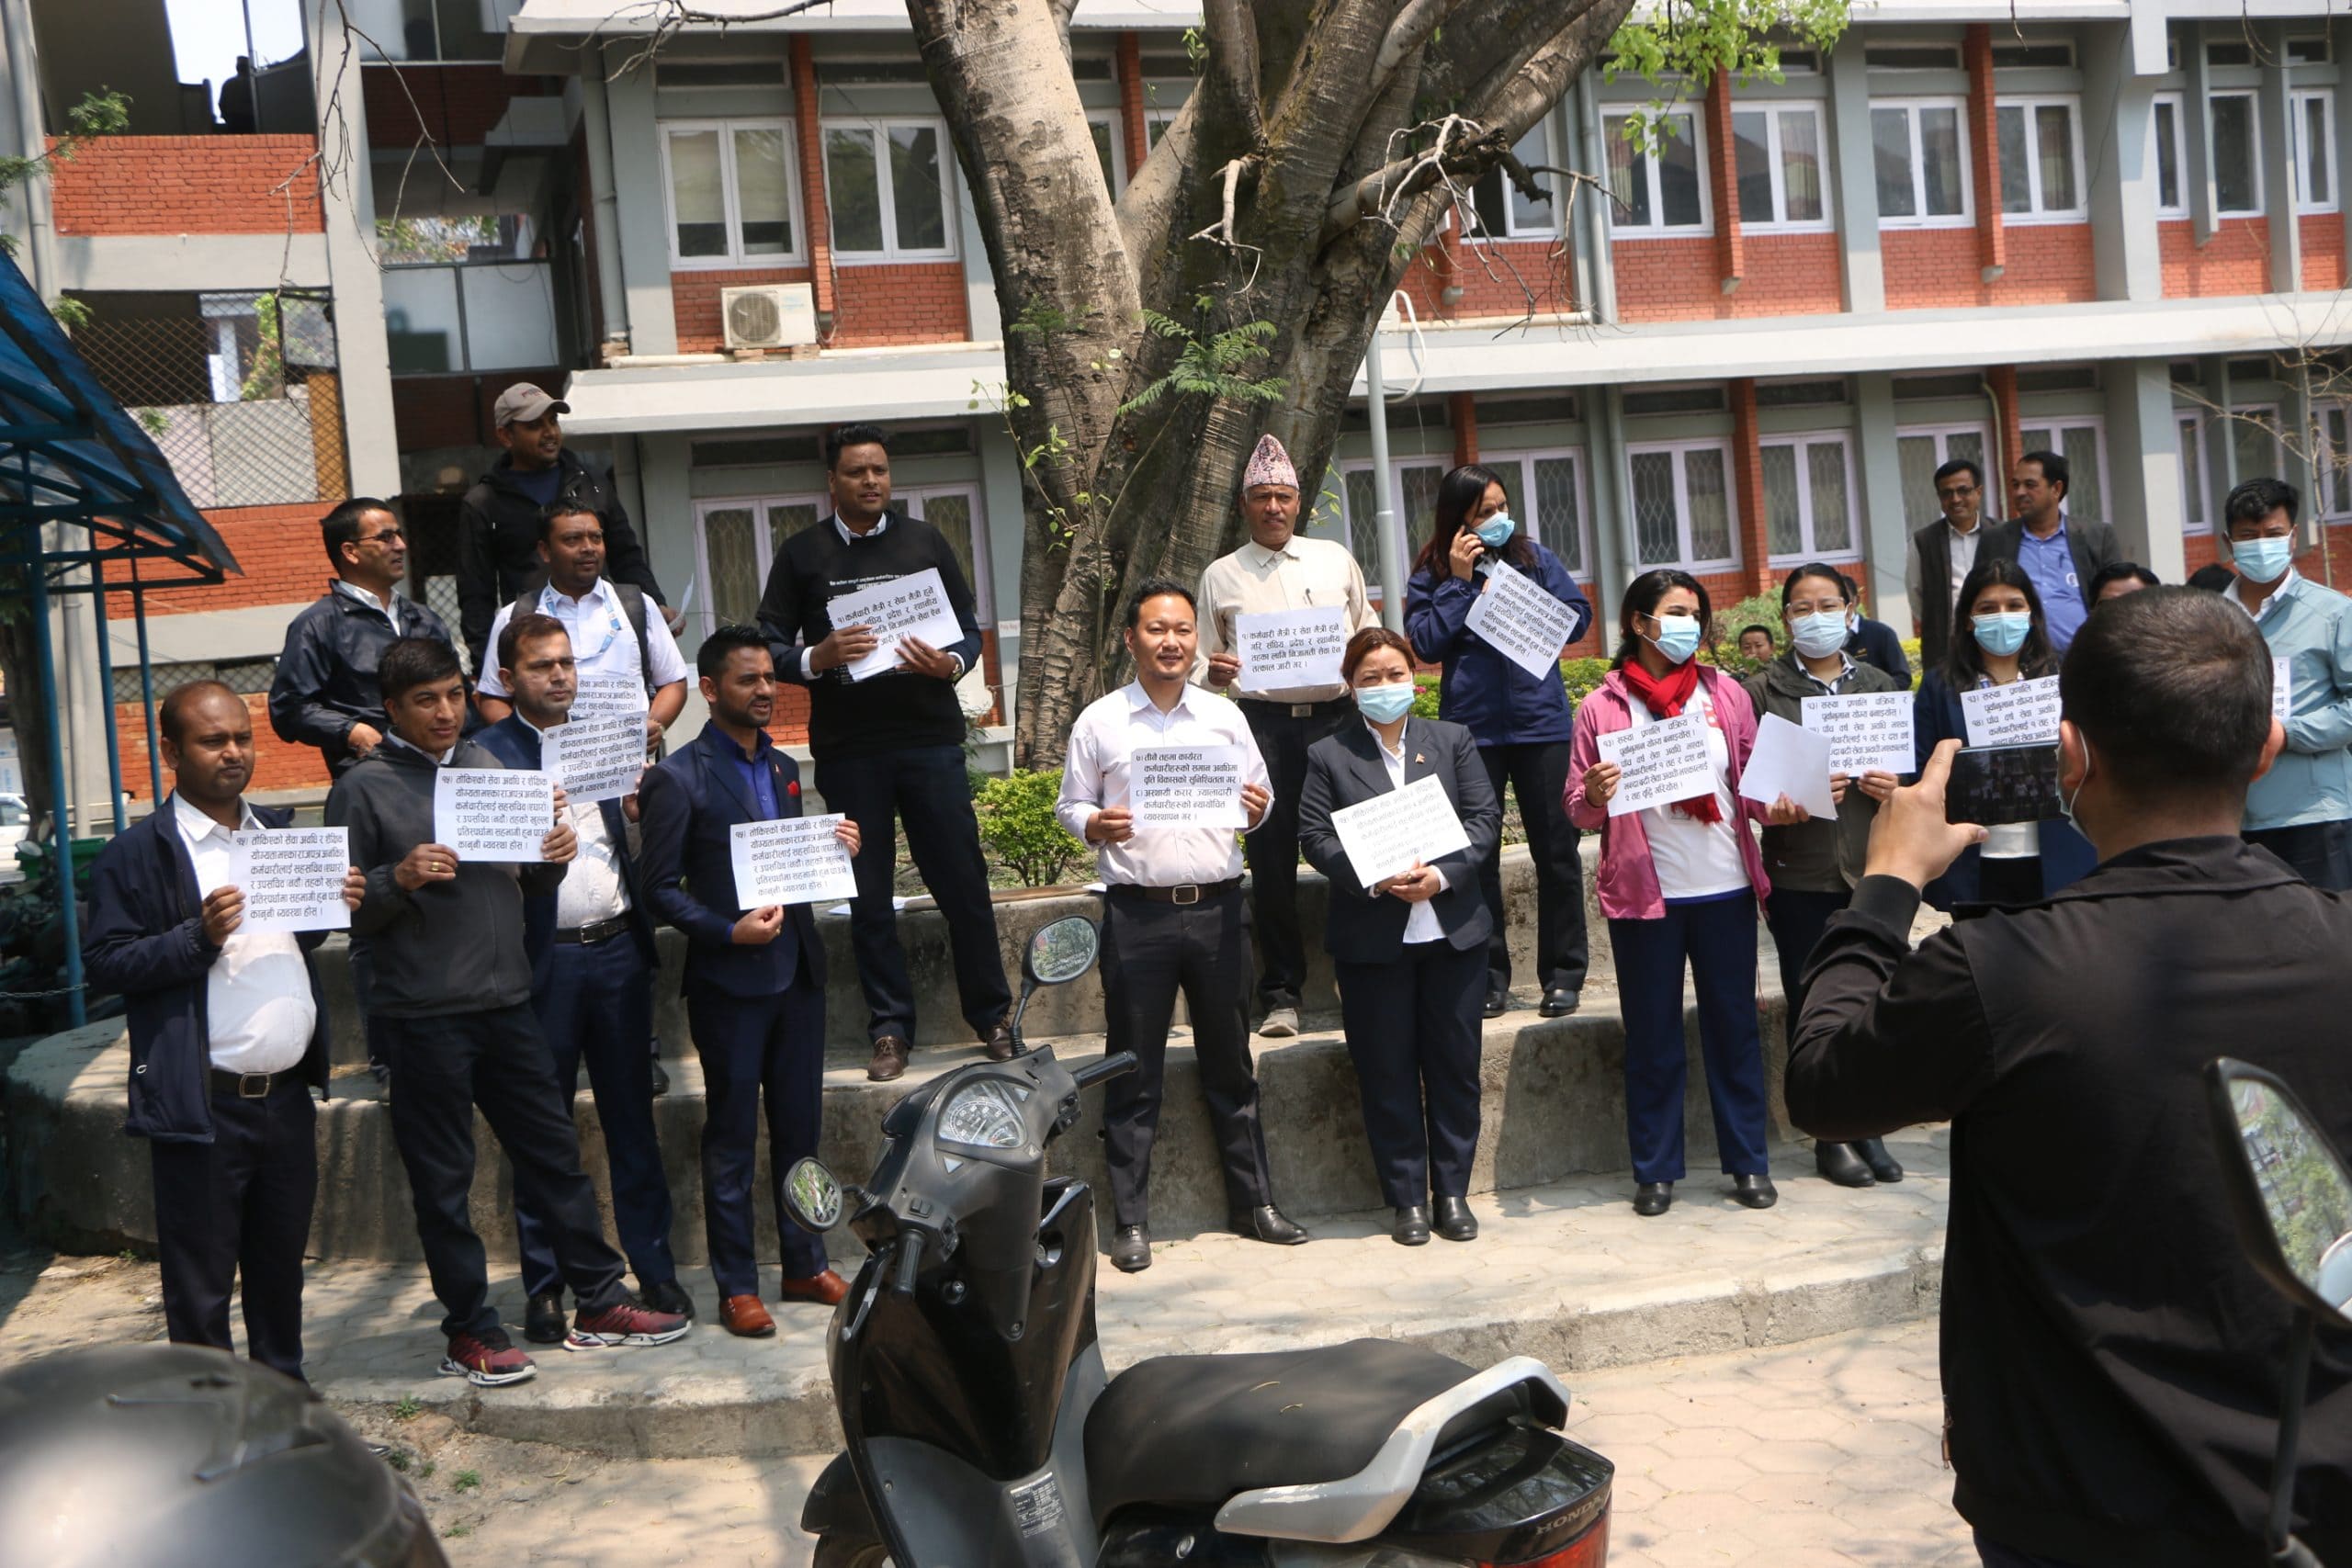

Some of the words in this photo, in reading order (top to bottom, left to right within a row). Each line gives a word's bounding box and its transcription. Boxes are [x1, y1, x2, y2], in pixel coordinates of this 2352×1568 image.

[894, 596, 906, 605] सेवा
[923, 586, 933, 596] हुने
[918, 612, 930, 621] सेवा
[931, 608, 941, 616] ऐन
[1250, 630, 1274, 639] कर्मचारी
[1329, 623, 1339, 633] हुने
[1318, 647, 1329, 655] सेवा
[1277, 660, 1291, 670] जारी
[1853, 723, 1864, 731] सेवा
[1831, 735, 1860, 743] र्मचारीलाई
[1179, 752, 1202, 761] कार्यरत
[1213, 762, 1238, 772] अवधिमा
[488, 774, 500, 784] सेवा
[503, 774, 520, 784] अवधि
[1157, 774, 1186, 784] विकासको
[1190, 774, 1224, 784] सुनिश्चितता
[1145, 788, 1170, 796] अस्थायी
[1198, 787, 1232, 796] ज्यालादारी
[456, 801, 496, 811] कर्मचारीलाई
[498, 801, 526, 811] सहसचिव
[463, 813, 490, 823] उपसचिव
[509, 814, 528, 824] तहको
[780, 824, 792, 833] सेवा
[794, 820, 811, 831] अवधि
[286, 834, 298, 844] सेवा
[300, 833, 317, 844] अवधि
[752, 849, 790, 861] कर्मचारीलाई
[251, 863, 292, 874] कर्मचारीलाई
[257, 877, 284, 889] उपसचिव
[305, 876, 323, 887] तहको
[1535, 1495, 1602, 1535] HONDA
